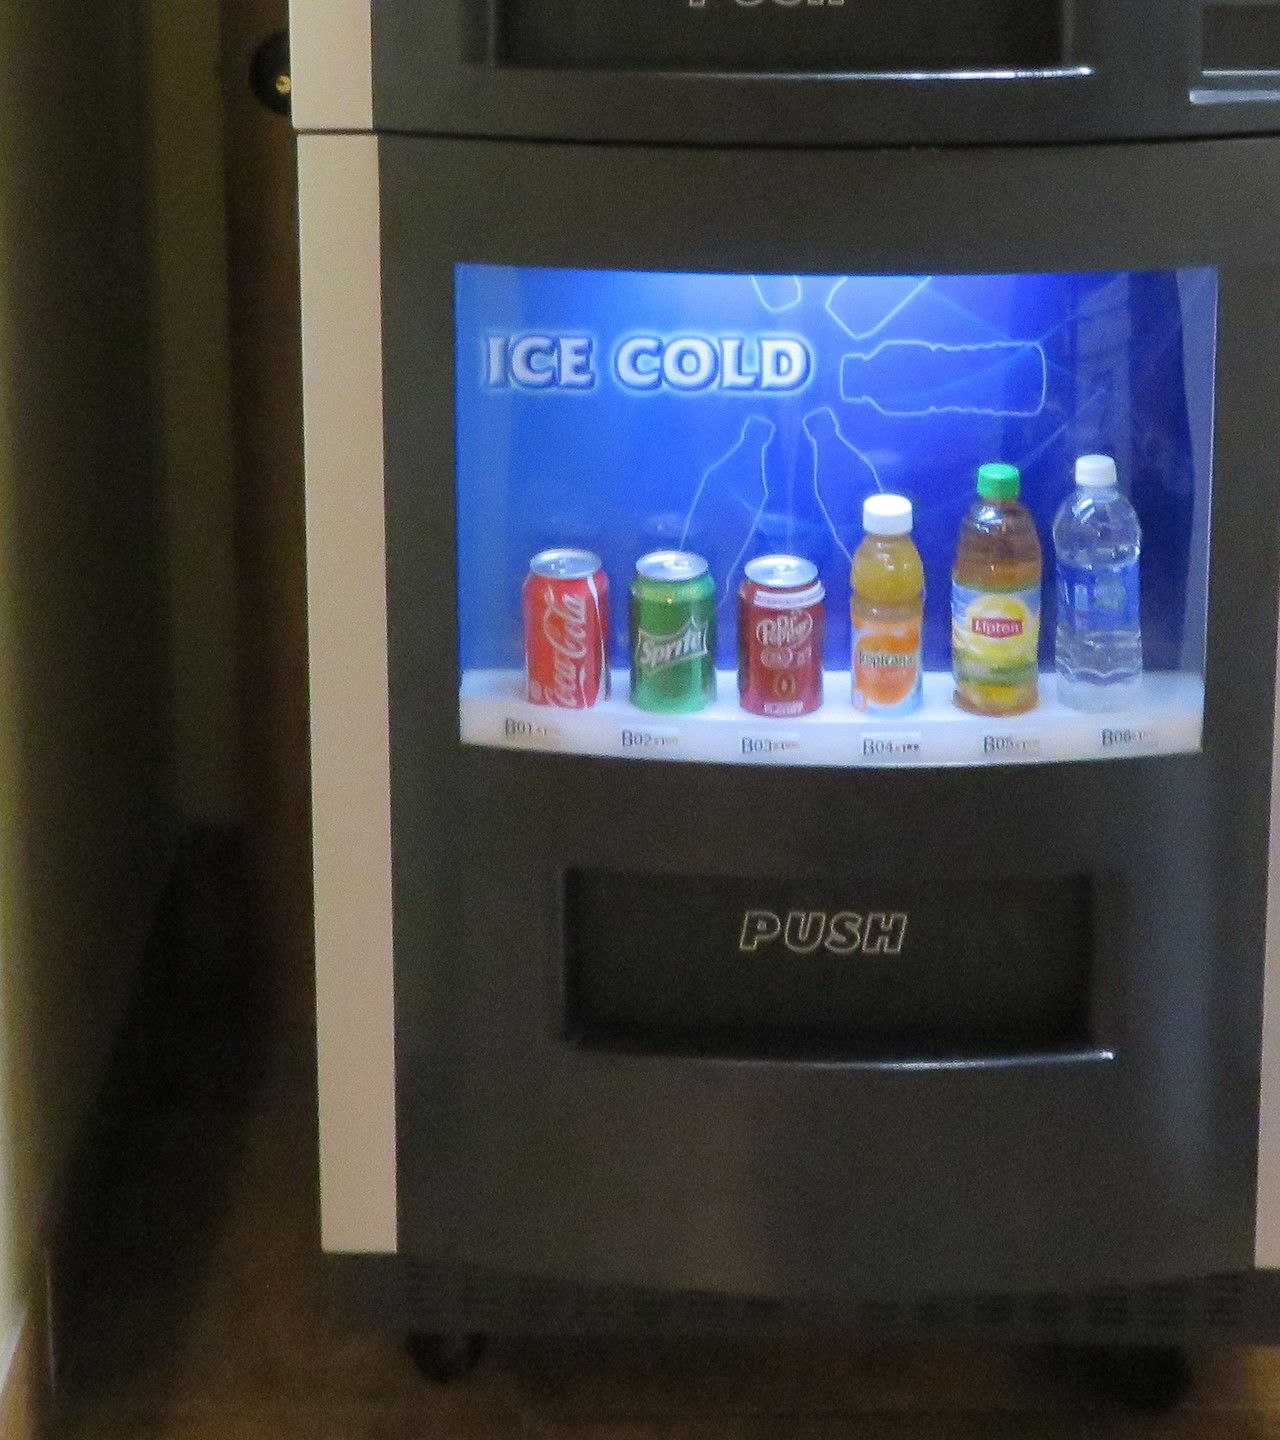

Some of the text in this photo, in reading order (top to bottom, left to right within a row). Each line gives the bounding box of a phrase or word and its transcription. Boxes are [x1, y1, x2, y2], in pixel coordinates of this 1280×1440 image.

[486, 333, 812, 392] ICE COLD
[975, 620, 1019, 635] Lipton
[640, 628, 704, 668] Sprite
[621, 728, 651, 748] B02
[741, 736, 772, 755] B03
[863, 738, 893, 756] B04
[739, 911, 907, 954] PUSH
